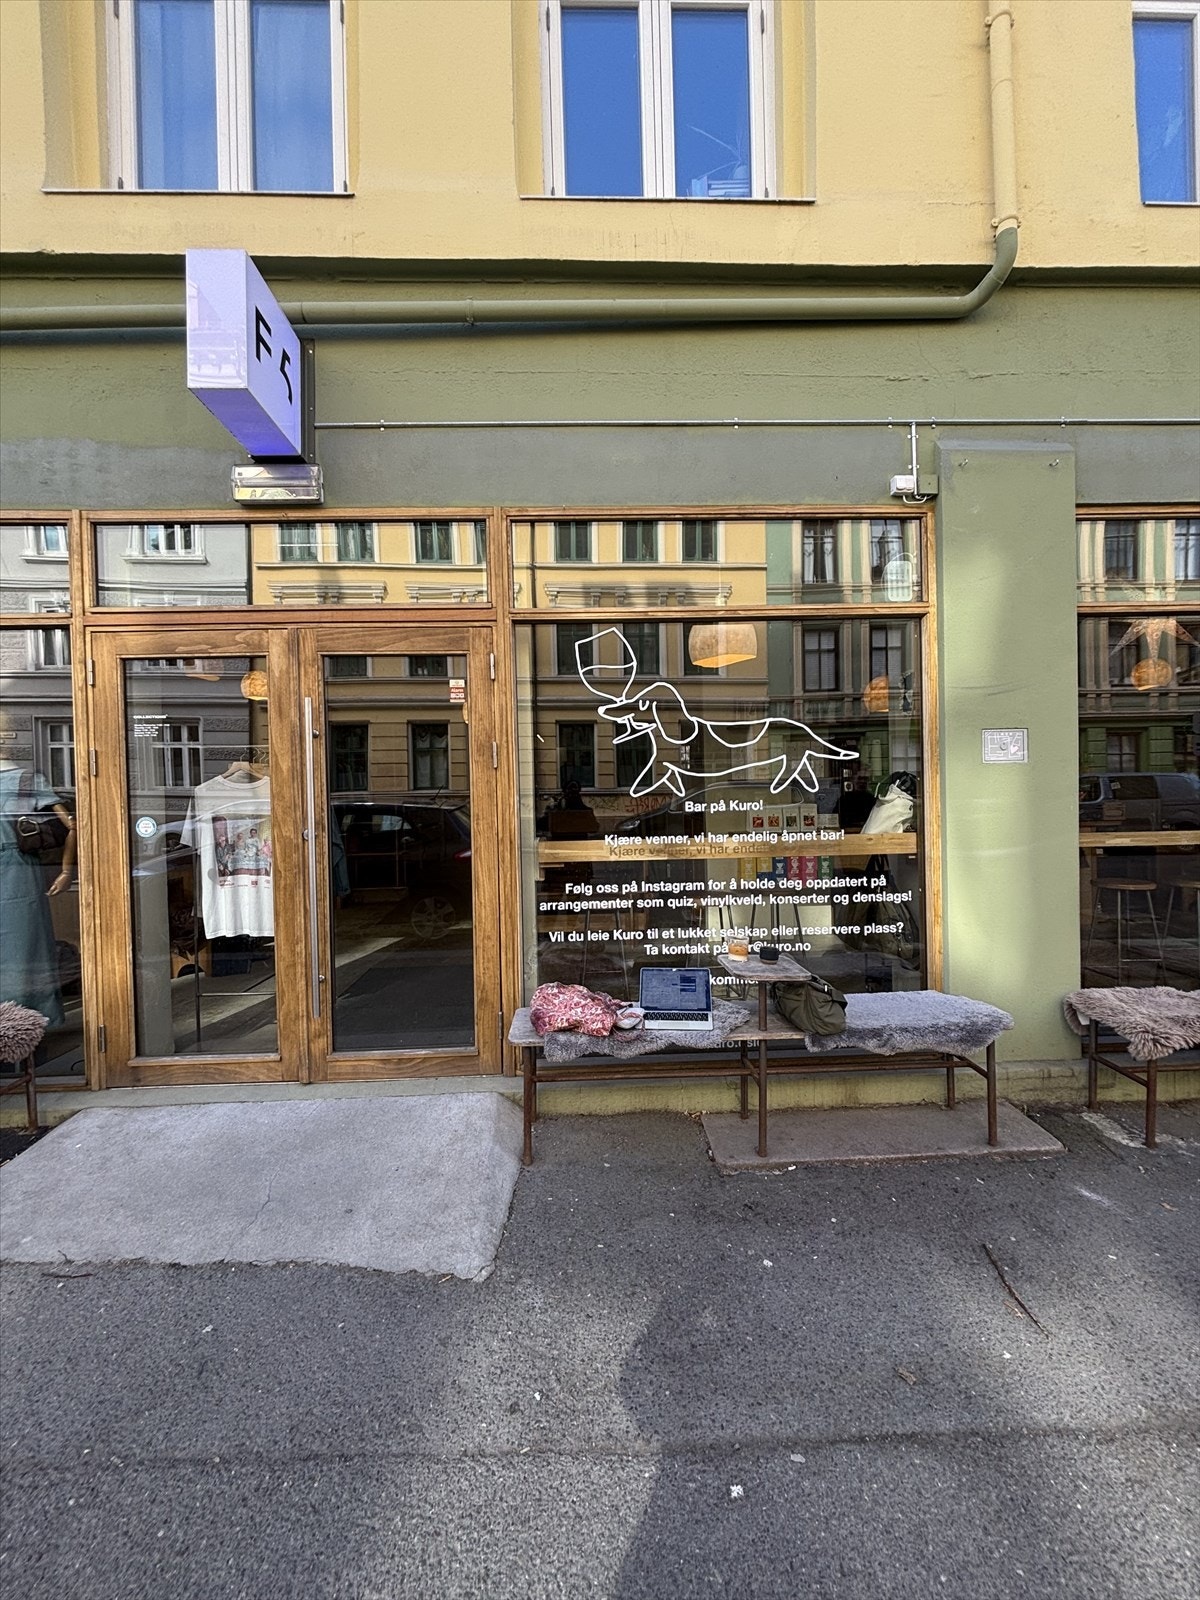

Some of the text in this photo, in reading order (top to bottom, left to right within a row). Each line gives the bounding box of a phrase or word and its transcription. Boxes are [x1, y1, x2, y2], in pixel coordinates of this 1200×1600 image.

[684, 799, 764, 814] Bar på Kuro!
[604, 829, 845, 847] Kjære venner, vi har endelig åpnet bar!
[565, 874, 887, 896] Følg oss på Instagram for å holde deg oppdatert på
[539, 890, 912, 913] arrangementer som quiz, vinylkveld, konserter og denslags!
[548, 921, 904, 943] Vil du leie Kuro til et lukket selskap eller reservere plass?
[643, 944, 659, 956] Ta
[661, 943, 710, 955] kontakt
[713, 942, 728, 956] på
